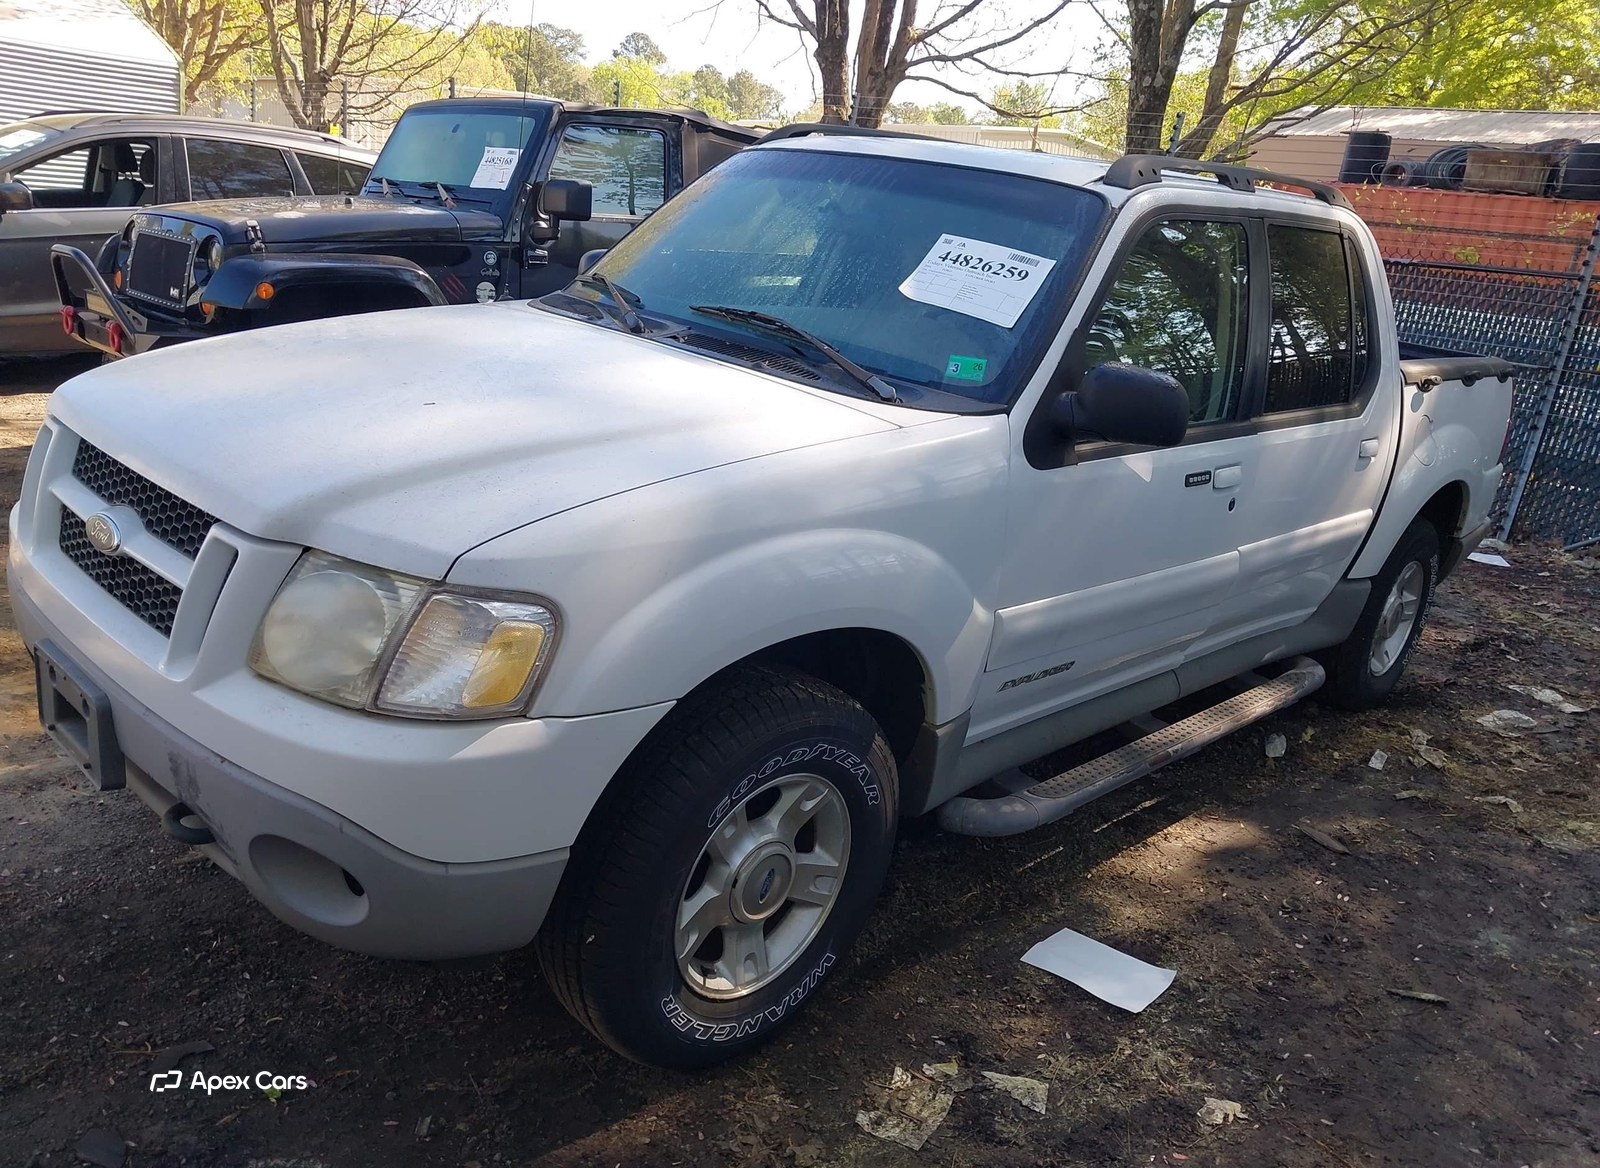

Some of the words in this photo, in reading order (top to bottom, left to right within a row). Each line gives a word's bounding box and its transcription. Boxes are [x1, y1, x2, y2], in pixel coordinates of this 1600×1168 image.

[938, 250, 1029, 282] 44826259
[952, 363, 960, 373] 3
[91, 520, 110, 544] Ford
[708, 743, 881, 828] GOODYEAR
[660, 953, 836, 1042] WRANGLER
